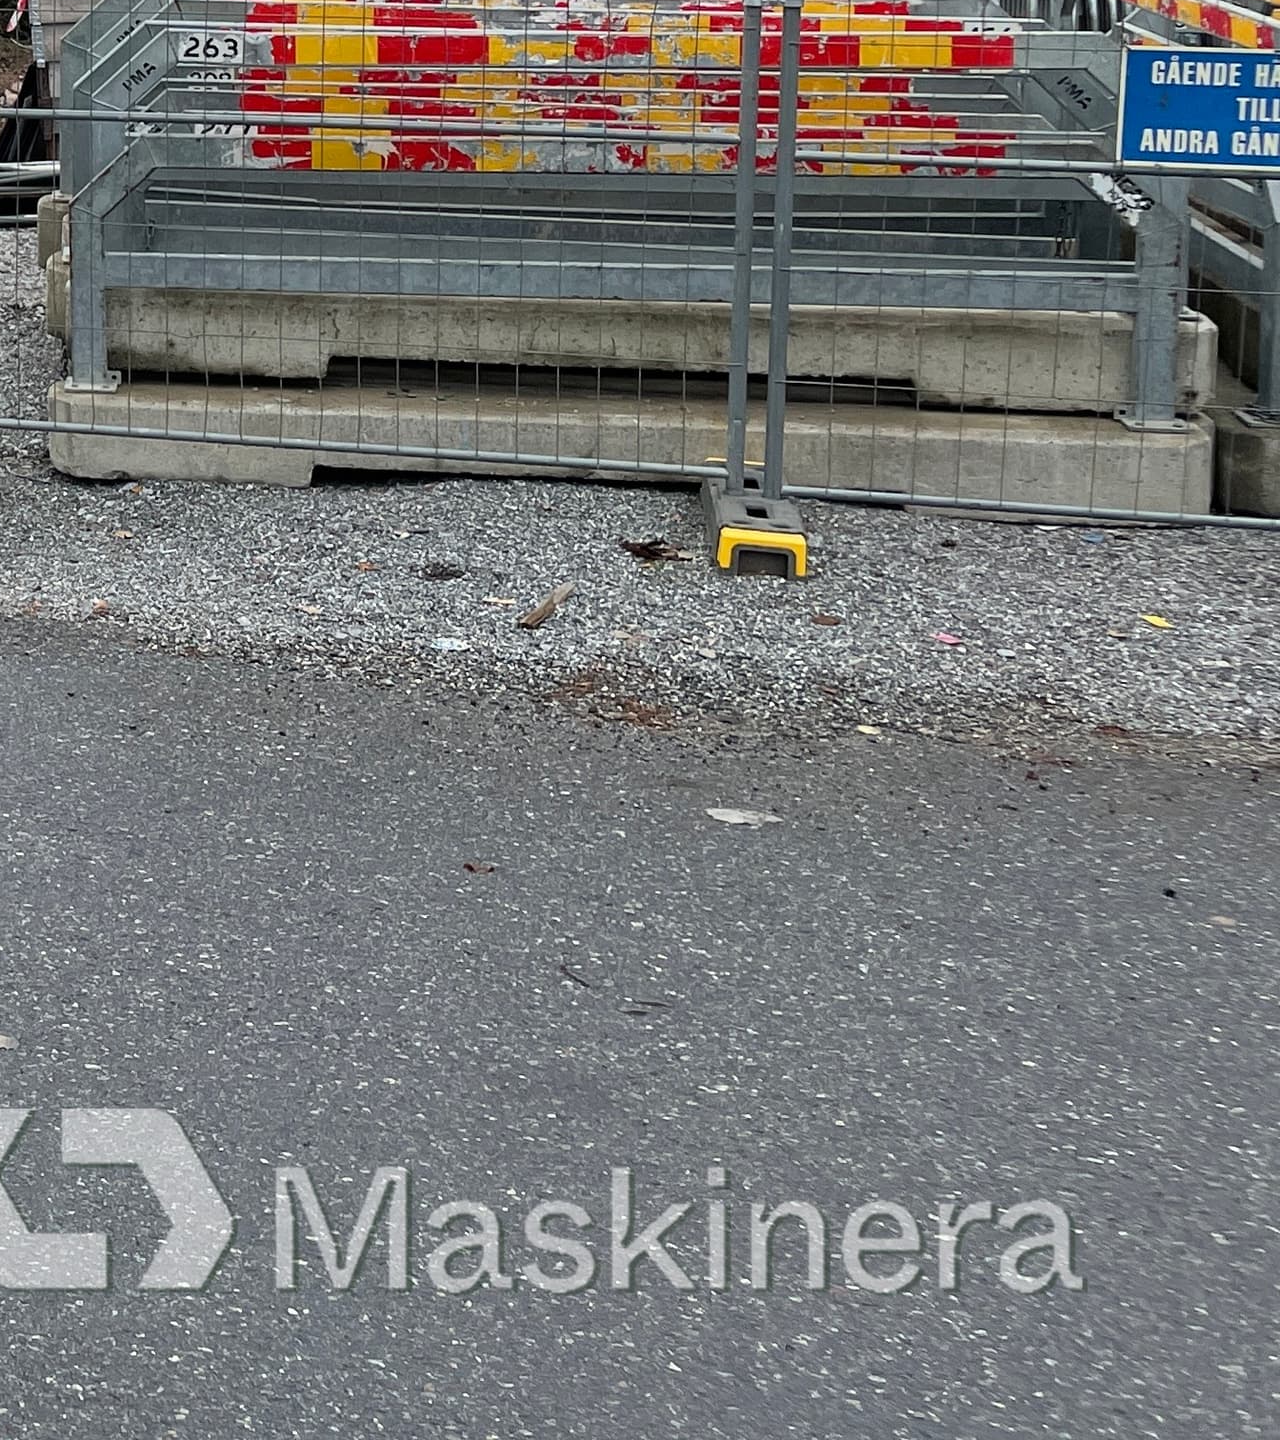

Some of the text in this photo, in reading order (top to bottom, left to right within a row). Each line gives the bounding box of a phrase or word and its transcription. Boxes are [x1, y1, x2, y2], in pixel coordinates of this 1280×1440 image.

[183, 37, 238, 59] 263
[122, 62, 156, 92] PMA
[1151, 55, 1242, 87] GÅENDE
[1140, 127, 1219, 155] ANDRA
